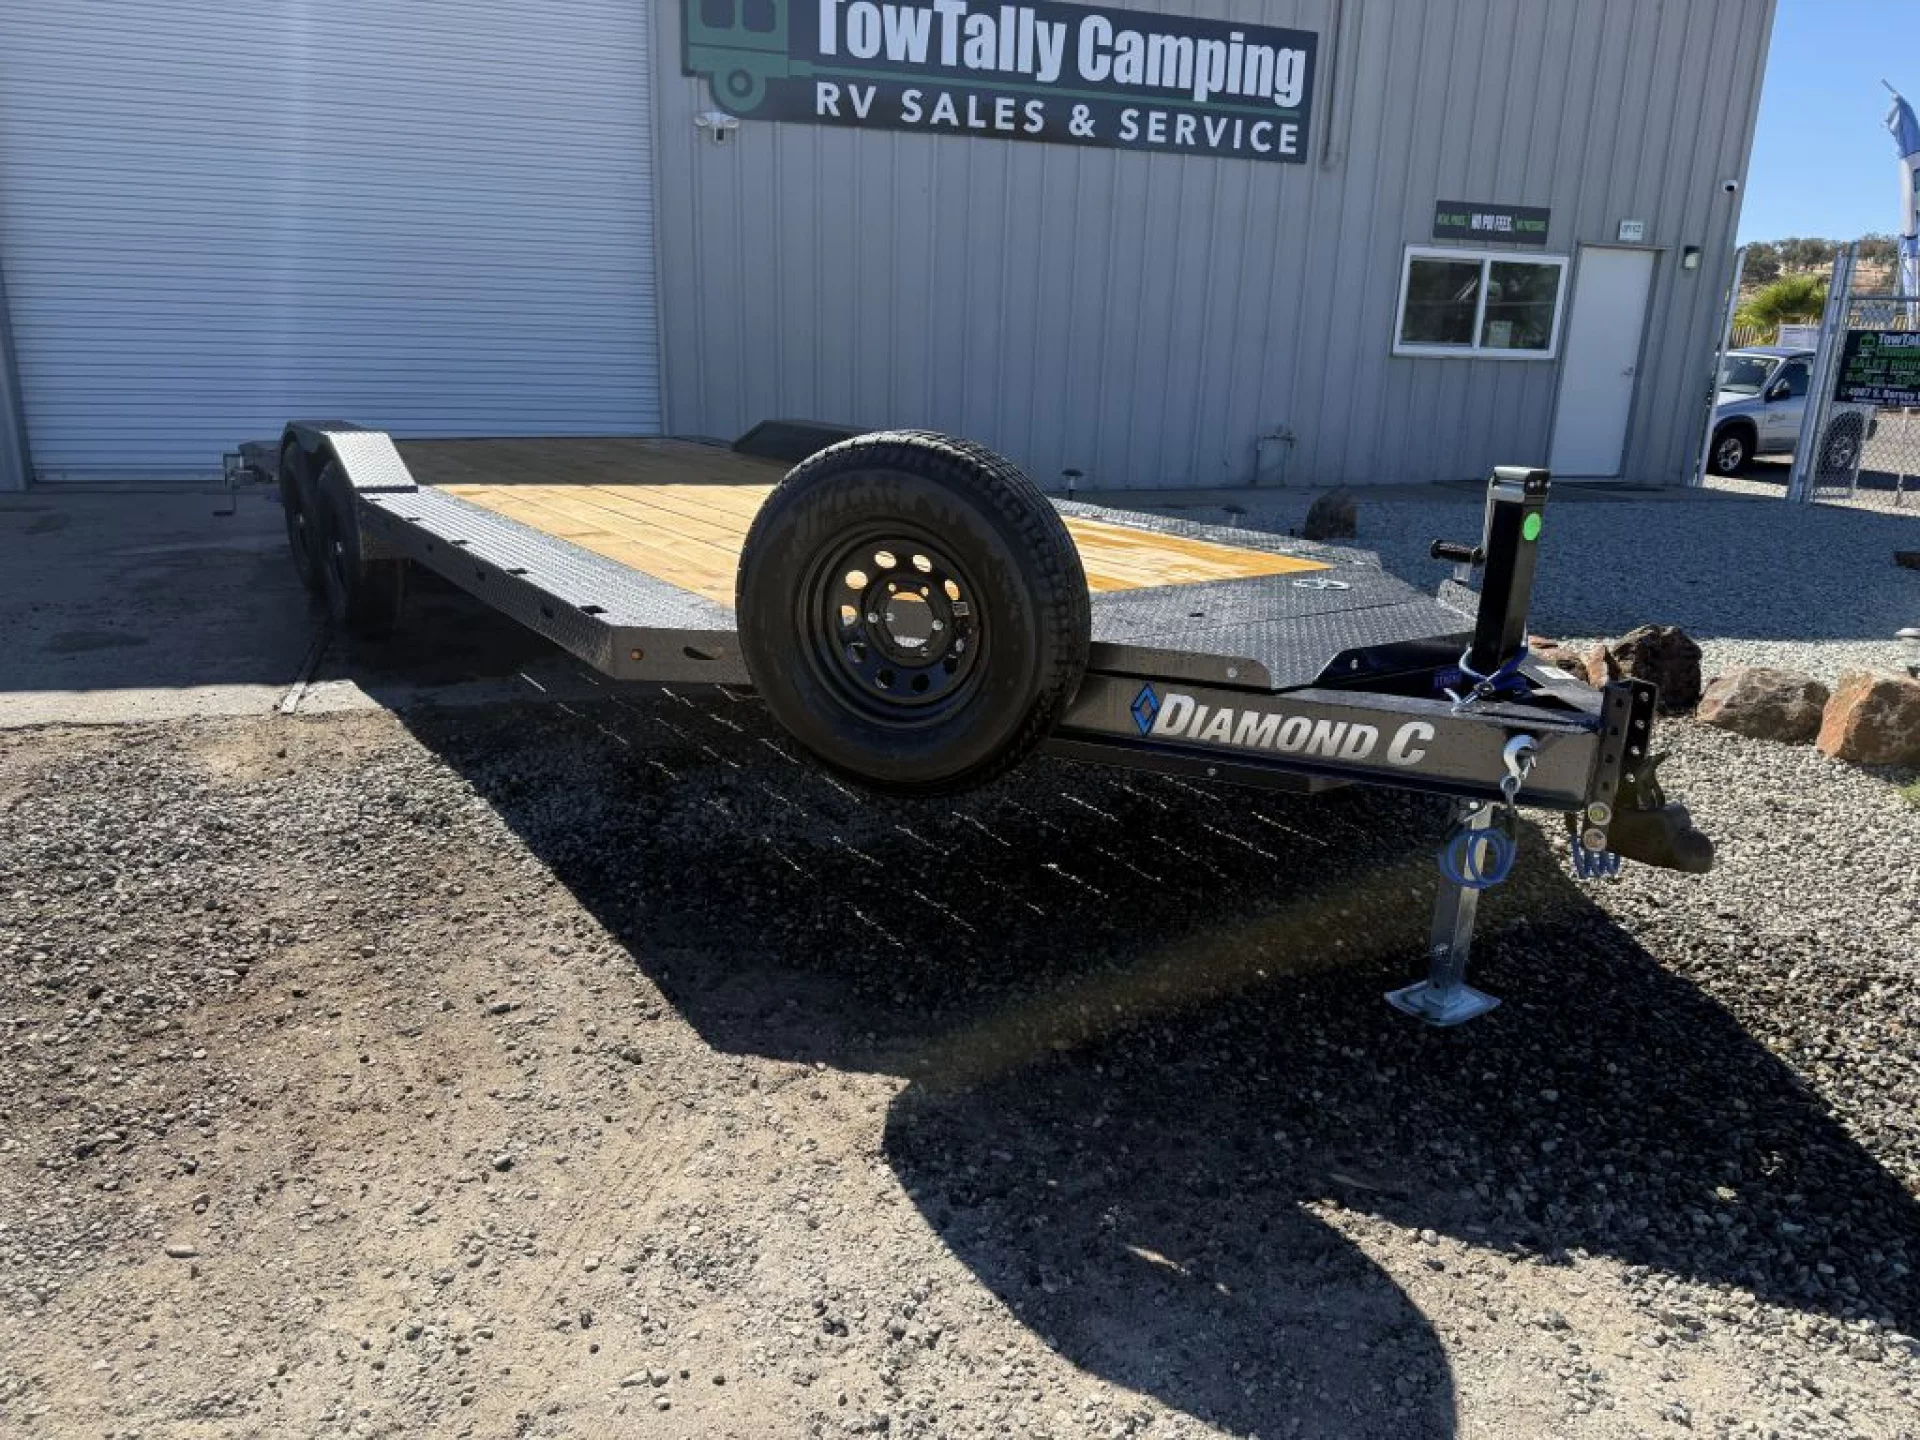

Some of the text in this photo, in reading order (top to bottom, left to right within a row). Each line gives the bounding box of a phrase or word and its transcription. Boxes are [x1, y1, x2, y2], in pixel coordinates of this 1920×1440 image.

[817, 0, 1306, 108] TowTally Camping
[816, 82, 1299, 154] RV SALES & SERVICE
[1154, 693, 1436, 766] DIAMOND C
